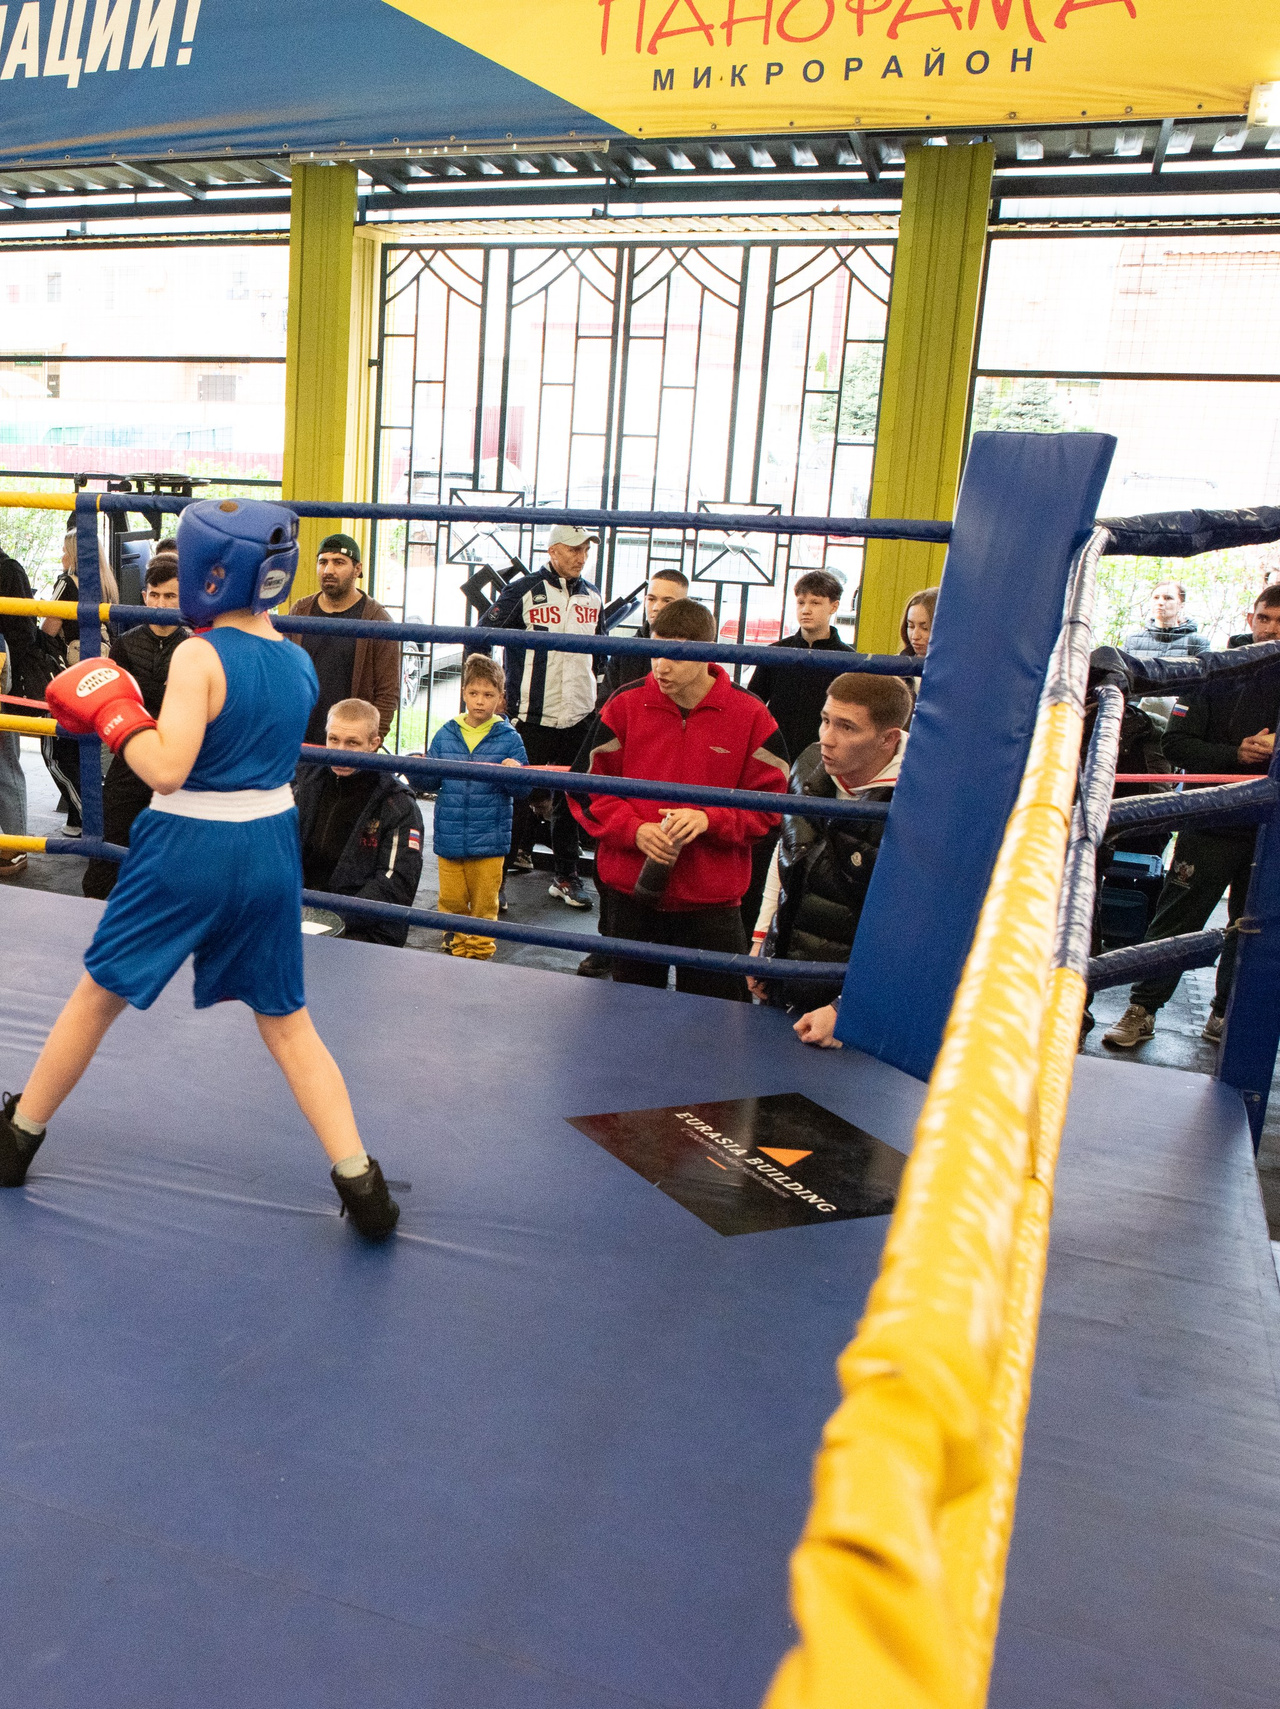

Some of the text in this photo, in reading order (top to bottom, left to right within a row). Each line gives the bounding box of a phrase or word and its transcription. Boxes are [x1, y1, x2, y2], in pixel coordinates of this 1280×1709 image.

[652, 47, 1034, 91] МИКРОРАЙОН
[78, 669, 113, 692] GREEN
[103, 714, 124, 736] GYM
[674, 1111, 837, 1213] EURASIA BUILDING
